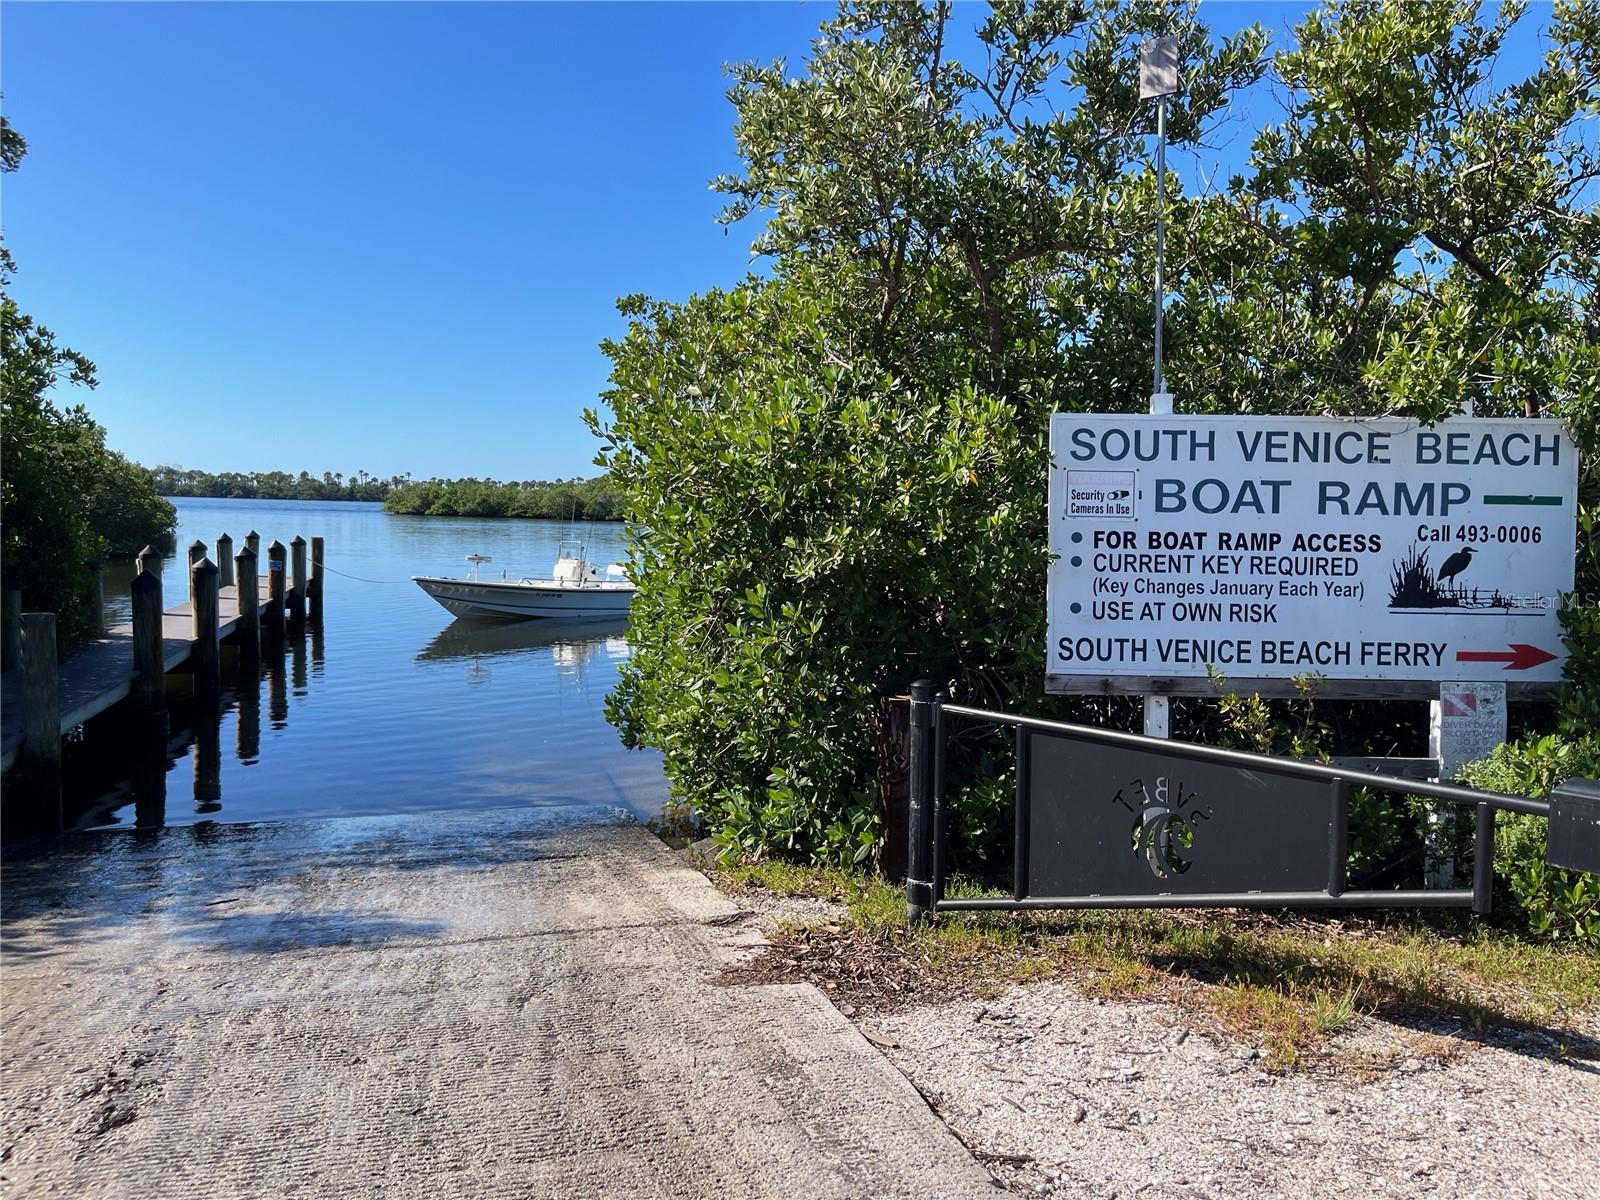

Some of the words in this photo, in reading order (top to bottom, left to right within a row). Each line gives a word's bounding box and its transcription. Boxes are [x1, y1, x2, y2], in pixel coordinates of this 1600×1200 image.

[1071, 428, 1215, 461] SOUTH
[1237, 431, 1391, 464] VENICE
[1416, 433, 1560, 466] BEACH
[1072, 489, 1104, 502] Security
[1155, 479, 1291, 514] BOAT
[1318, 481, 1470, 516] RAMP
[1071, 503, 1103, 514] Cameras
[1107, 504, 1113, 514] In
[1116, 504, 1129, 514] Use
[1094, 531, 1136, 549] FOR
[1149, 532, 1207, 549] BOAT
[1219, 533, 1281, 551] RAMP
[1292, 534, 1381, 552] ACCESS
[1418, 525, 1450, 541] Call
[1456, 525, 1541, 543] 493-0006
[1094, 554, 1194, 573] CURRENT
[1202, 555, 1243, 574] KEY
[1251, 556, 1358, 576] REQUIRED
[1094, 577, 1128, 597] (Key
[1135, 578, 1204, 598] Changes
[1210, 580, 1273, 599] January
[1280, 581, 1317, 596] Each
[1324, 582, 1363, 601] Year)
[1093, 601, 1133, 620] USE
[1140, 602, 1165, 620] AT
[1173, 603, 1221, 621] OWN
[1230, 604, 1277, 622] RISK
[1058, 637, 1146, 661] SOUTH
[1157, 639, 1251, 663] VENICE
[1262, 641, 1350, 665] BEACH
[1361, 642, 1447, 666] FERRY
[1443, 720, 1471, 729] DIVER
